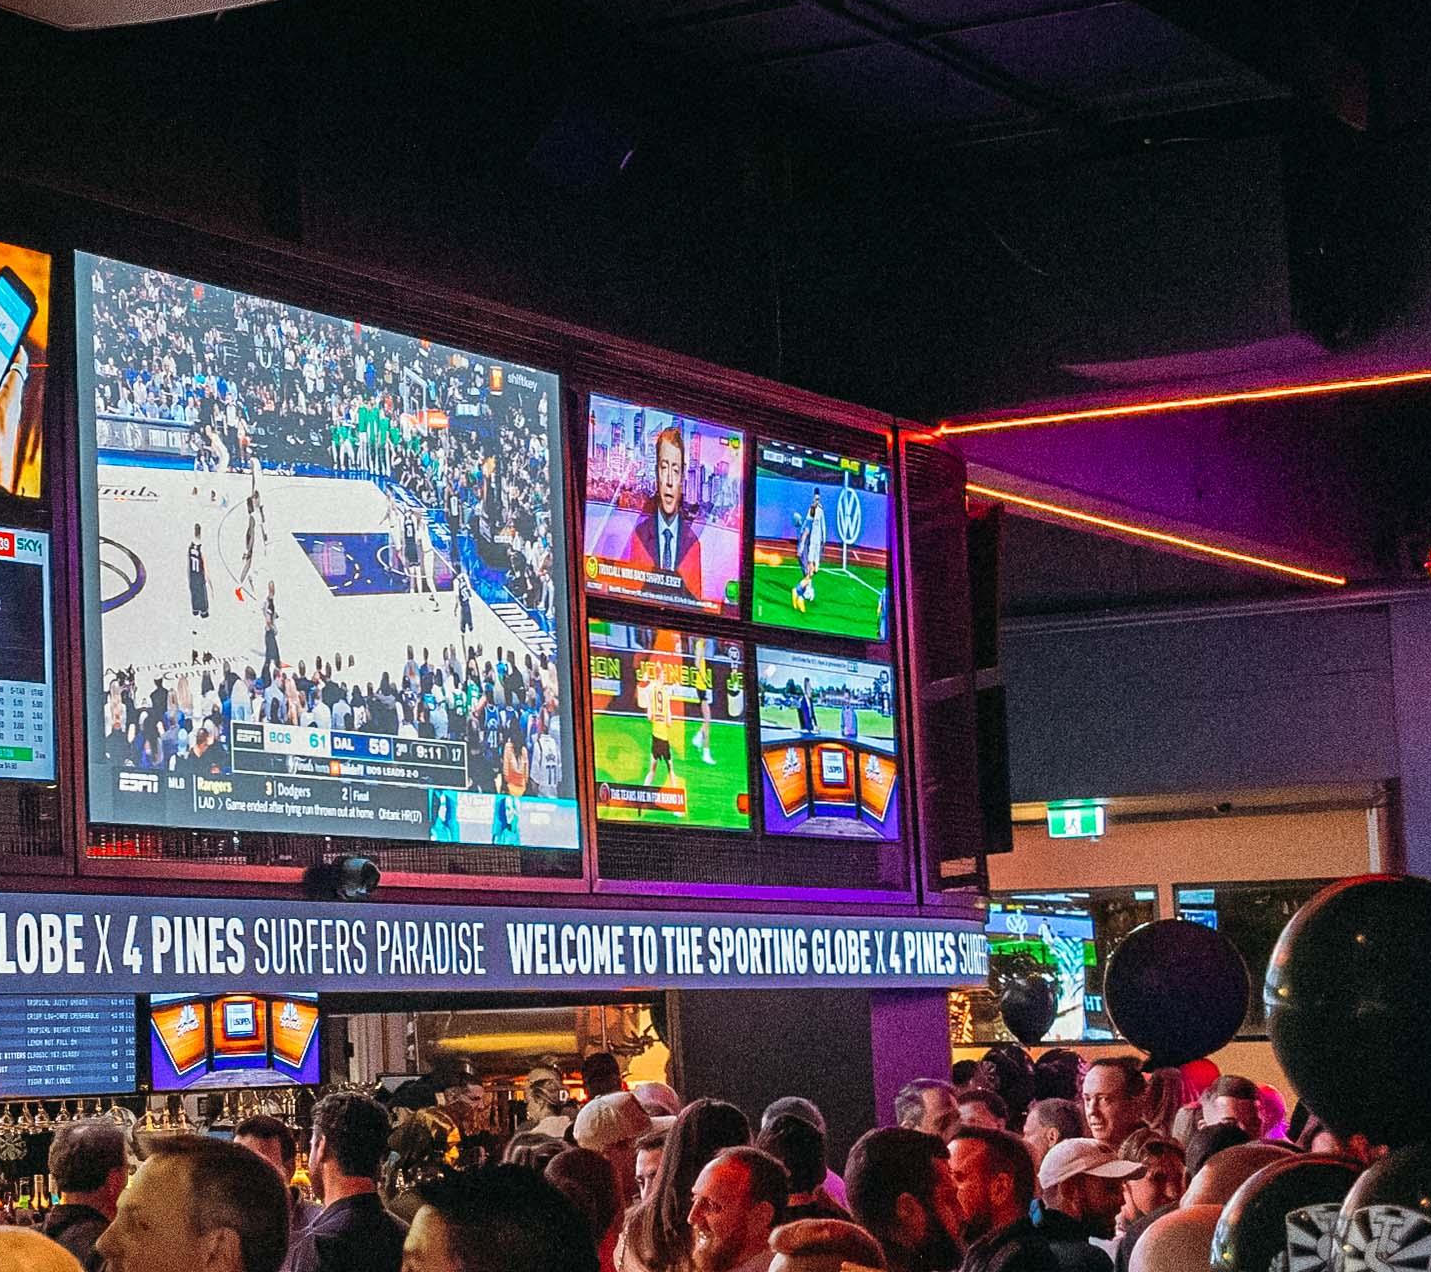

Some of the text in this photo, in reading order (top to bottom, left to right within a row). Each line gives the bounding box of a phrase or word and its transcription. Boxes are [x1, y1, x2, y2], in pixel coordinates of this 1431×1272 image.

[507, 373, 538, 393] shiftkey
[269, 731, 291, 745] BOS
[309, 733, 326, 749] 61
[333, 737, 355, 752] DAL
[416, 746, 442, 760] 9:11
[452, 748, 461, 761] 17
[118, 772, 370, 802] ESPN MLB Rangers 3 Dodgers 2 Final
[198, 796, 215, 810] LAD
[94, 914, 114, 974] X
[122, 915, 143, 974] 4
[151, 915, 246, 975] PINES
[254, 917, 367, 975] SURFERS
[376, 920, 486, 975] PARADISE
[506, 923, 626, 975] WELCOME
[629, 926, 658, 975] TO
[661, 926, 704, 975] THE
[708, 927, 808, 975] SPORTING
[811, 929, 872, 975] GLOBE
[874, 931, 887, 974] X
[889, 931, 901, 974] 4
[903, 931, 957, 975] PINES
